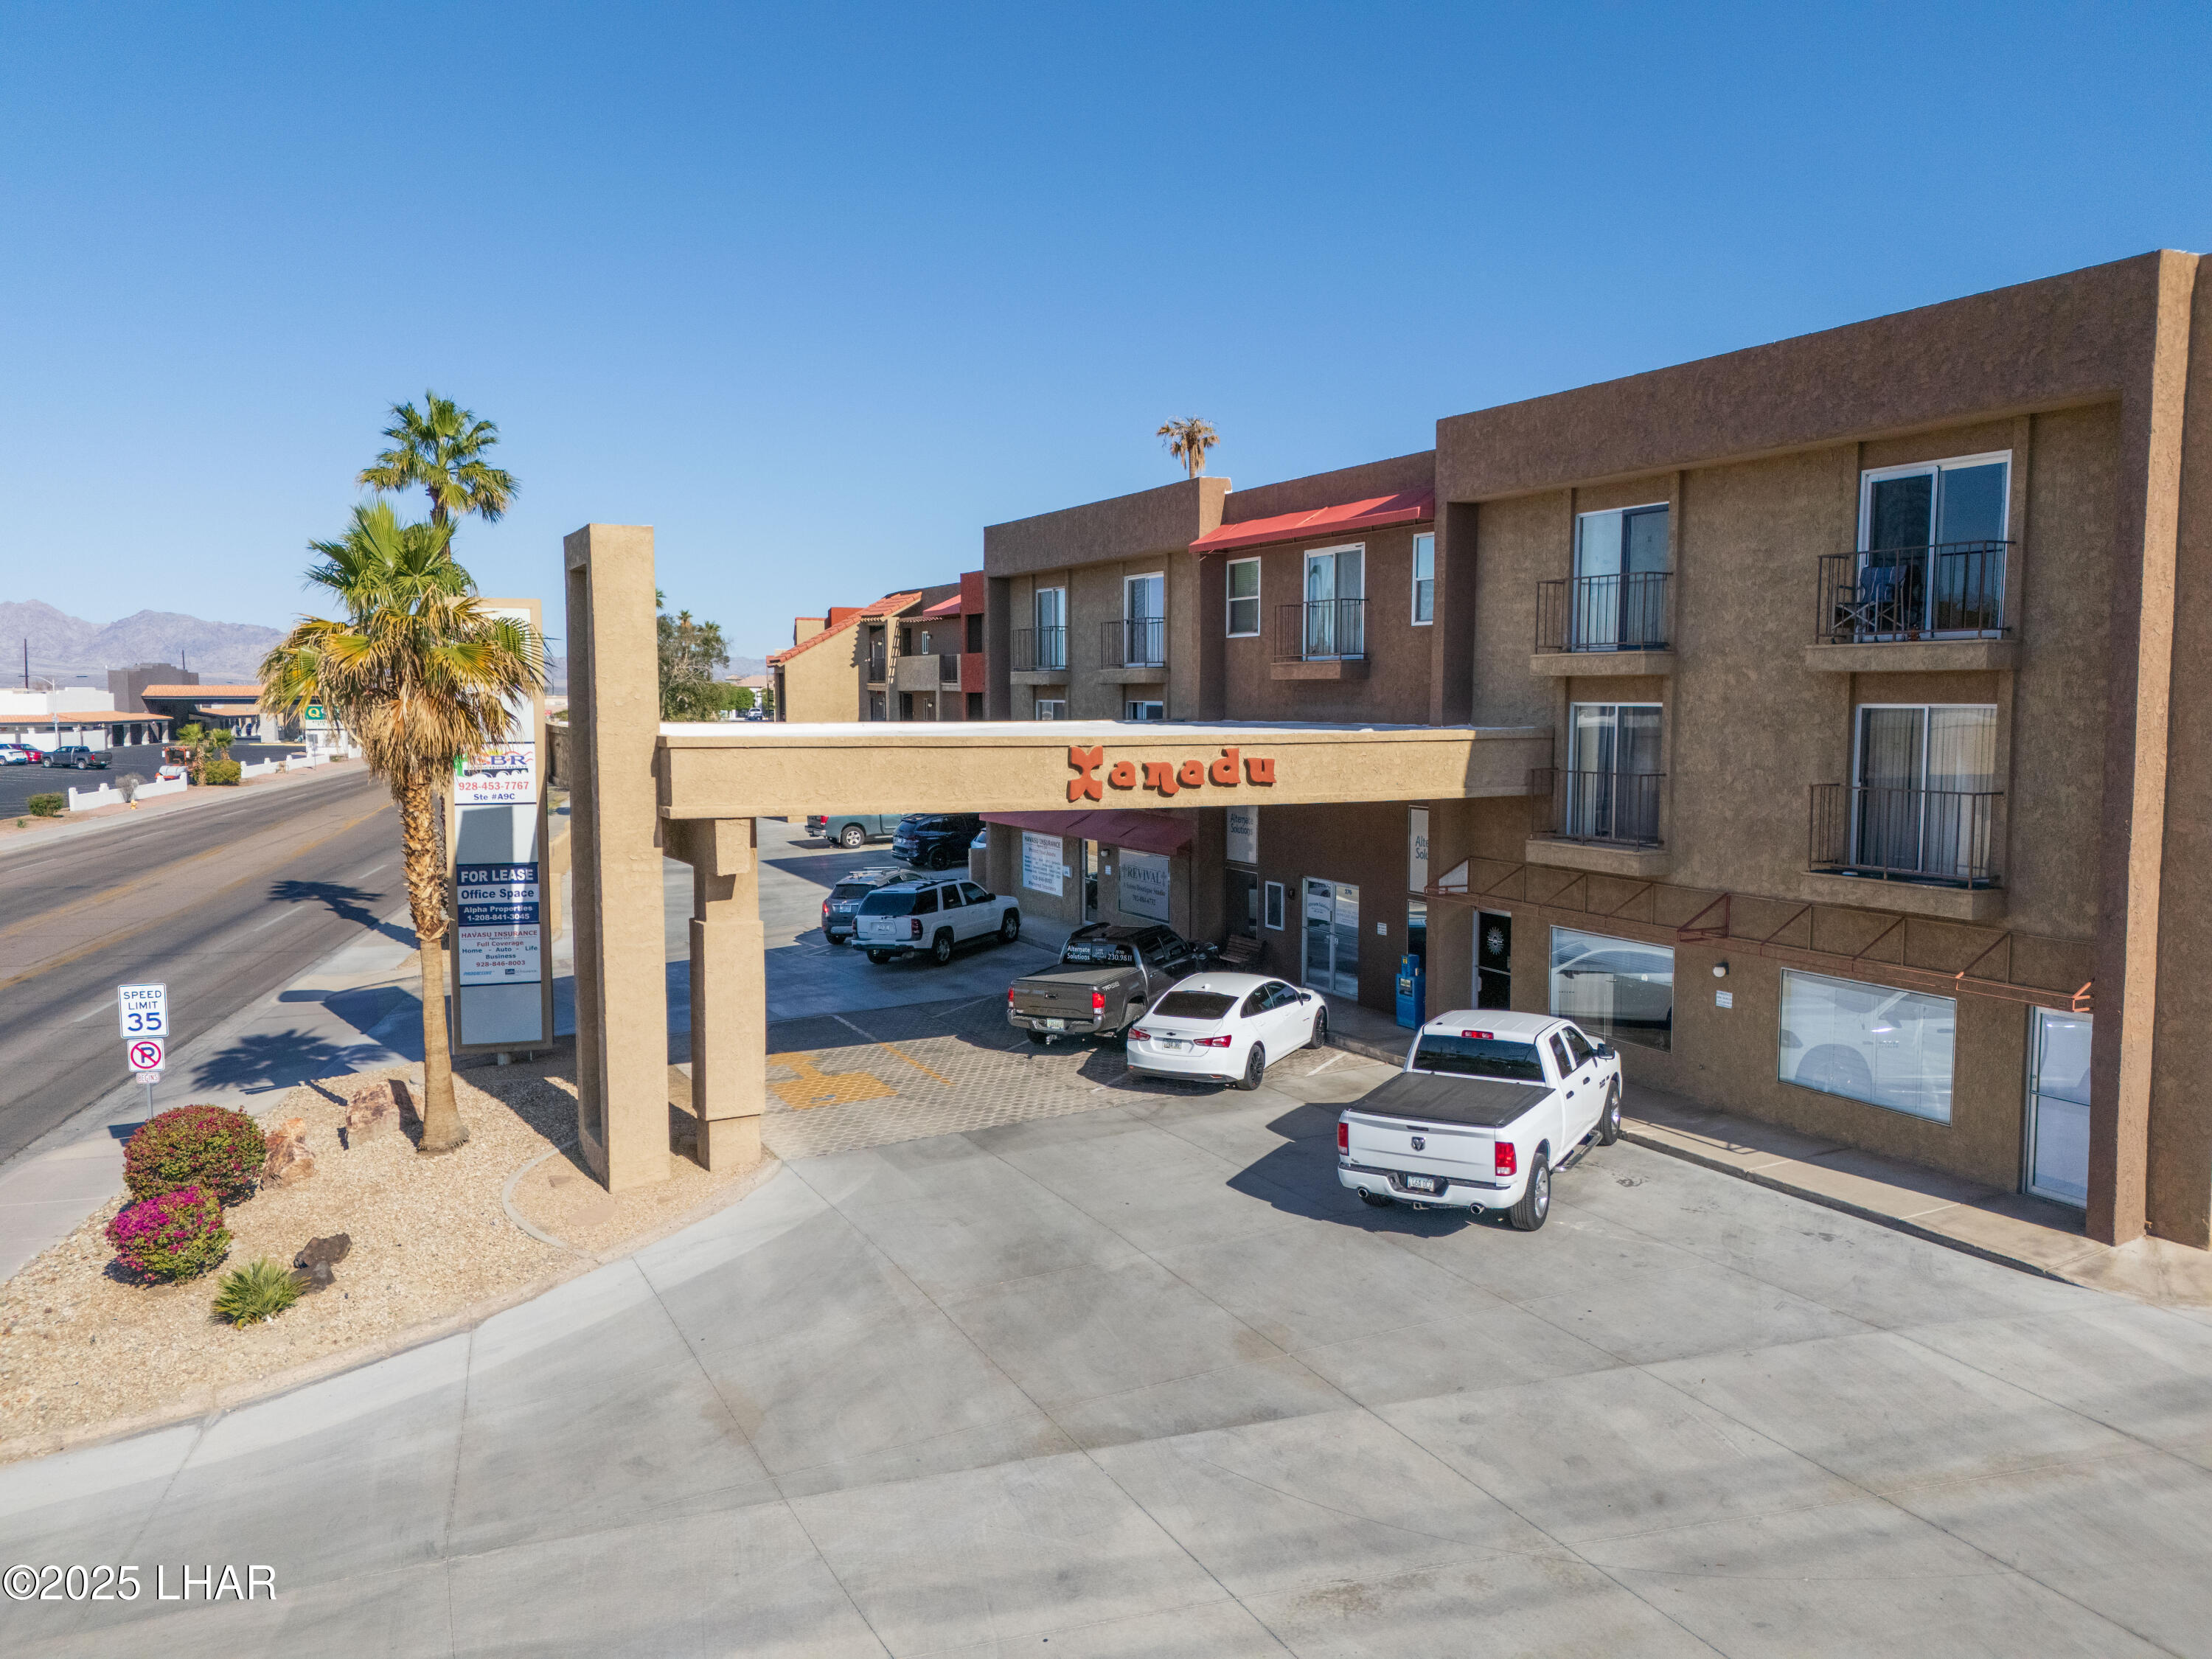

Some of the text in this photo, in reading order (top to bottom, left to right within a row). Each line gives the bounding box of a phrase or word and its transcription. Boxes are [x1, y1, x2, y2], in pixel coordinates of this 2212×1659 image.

[1068, 745, 1277, 801] Xanadu
[459, 782, 529, 791] 928-453-7767
[461, 869, 534, 883] FOR LEASE
[1127, 866, 1161, 884] REVIVAL
[461, 888, 535, 900] Office Space
[464, 906, 487, 914] Alpha
[467, 913, 530, 921] 1-208-841-3045
[1067, 945, 1091, 953] Alternate
[123, 990, 162, 1000] SPEED
[128, 1001, 158, 1010] LIMIT
[128, 1012, 162, 1032] 35
[138, 1073, 159, 1082] BEGINS
